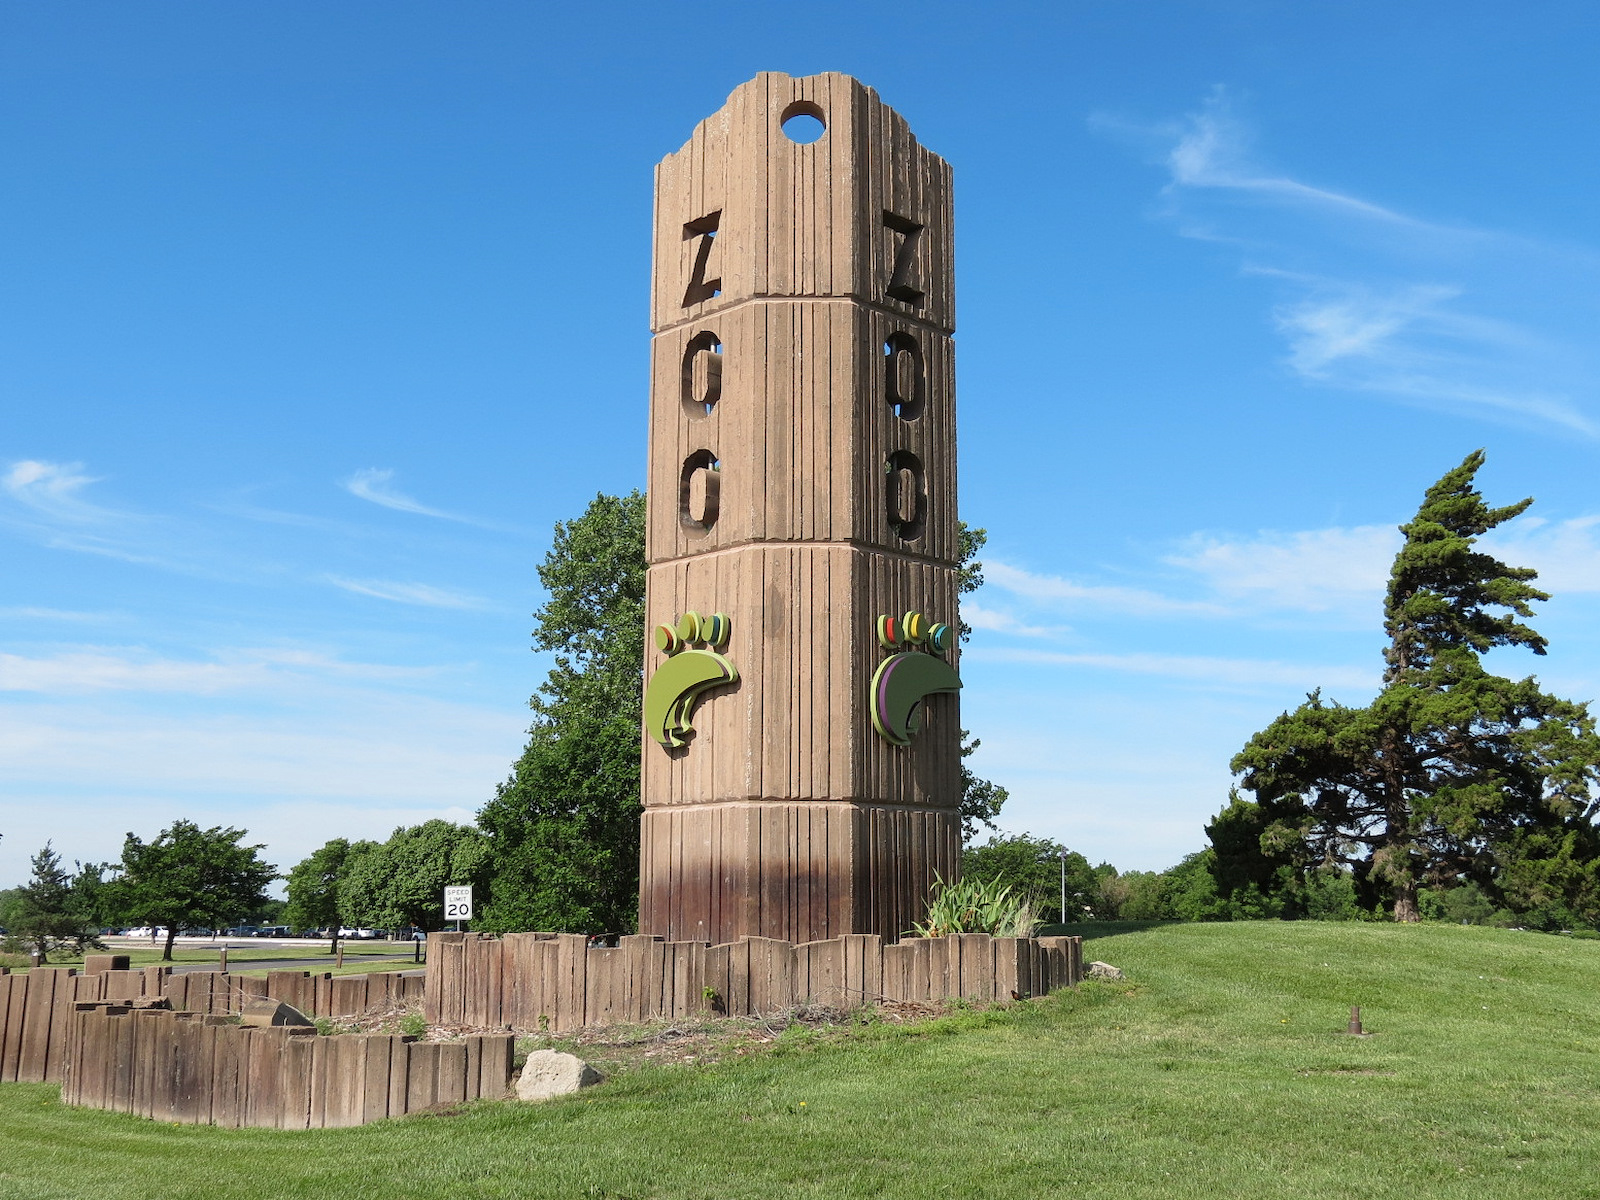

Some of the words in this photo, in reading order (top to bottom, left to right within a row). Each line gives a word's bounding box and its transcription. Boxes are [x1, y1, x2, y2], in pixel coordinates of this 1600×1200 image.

[680, 208, 722, 540] ZOO
[883, 209, 927, 542] ZOO
[448, 903, 469, 916] 20
